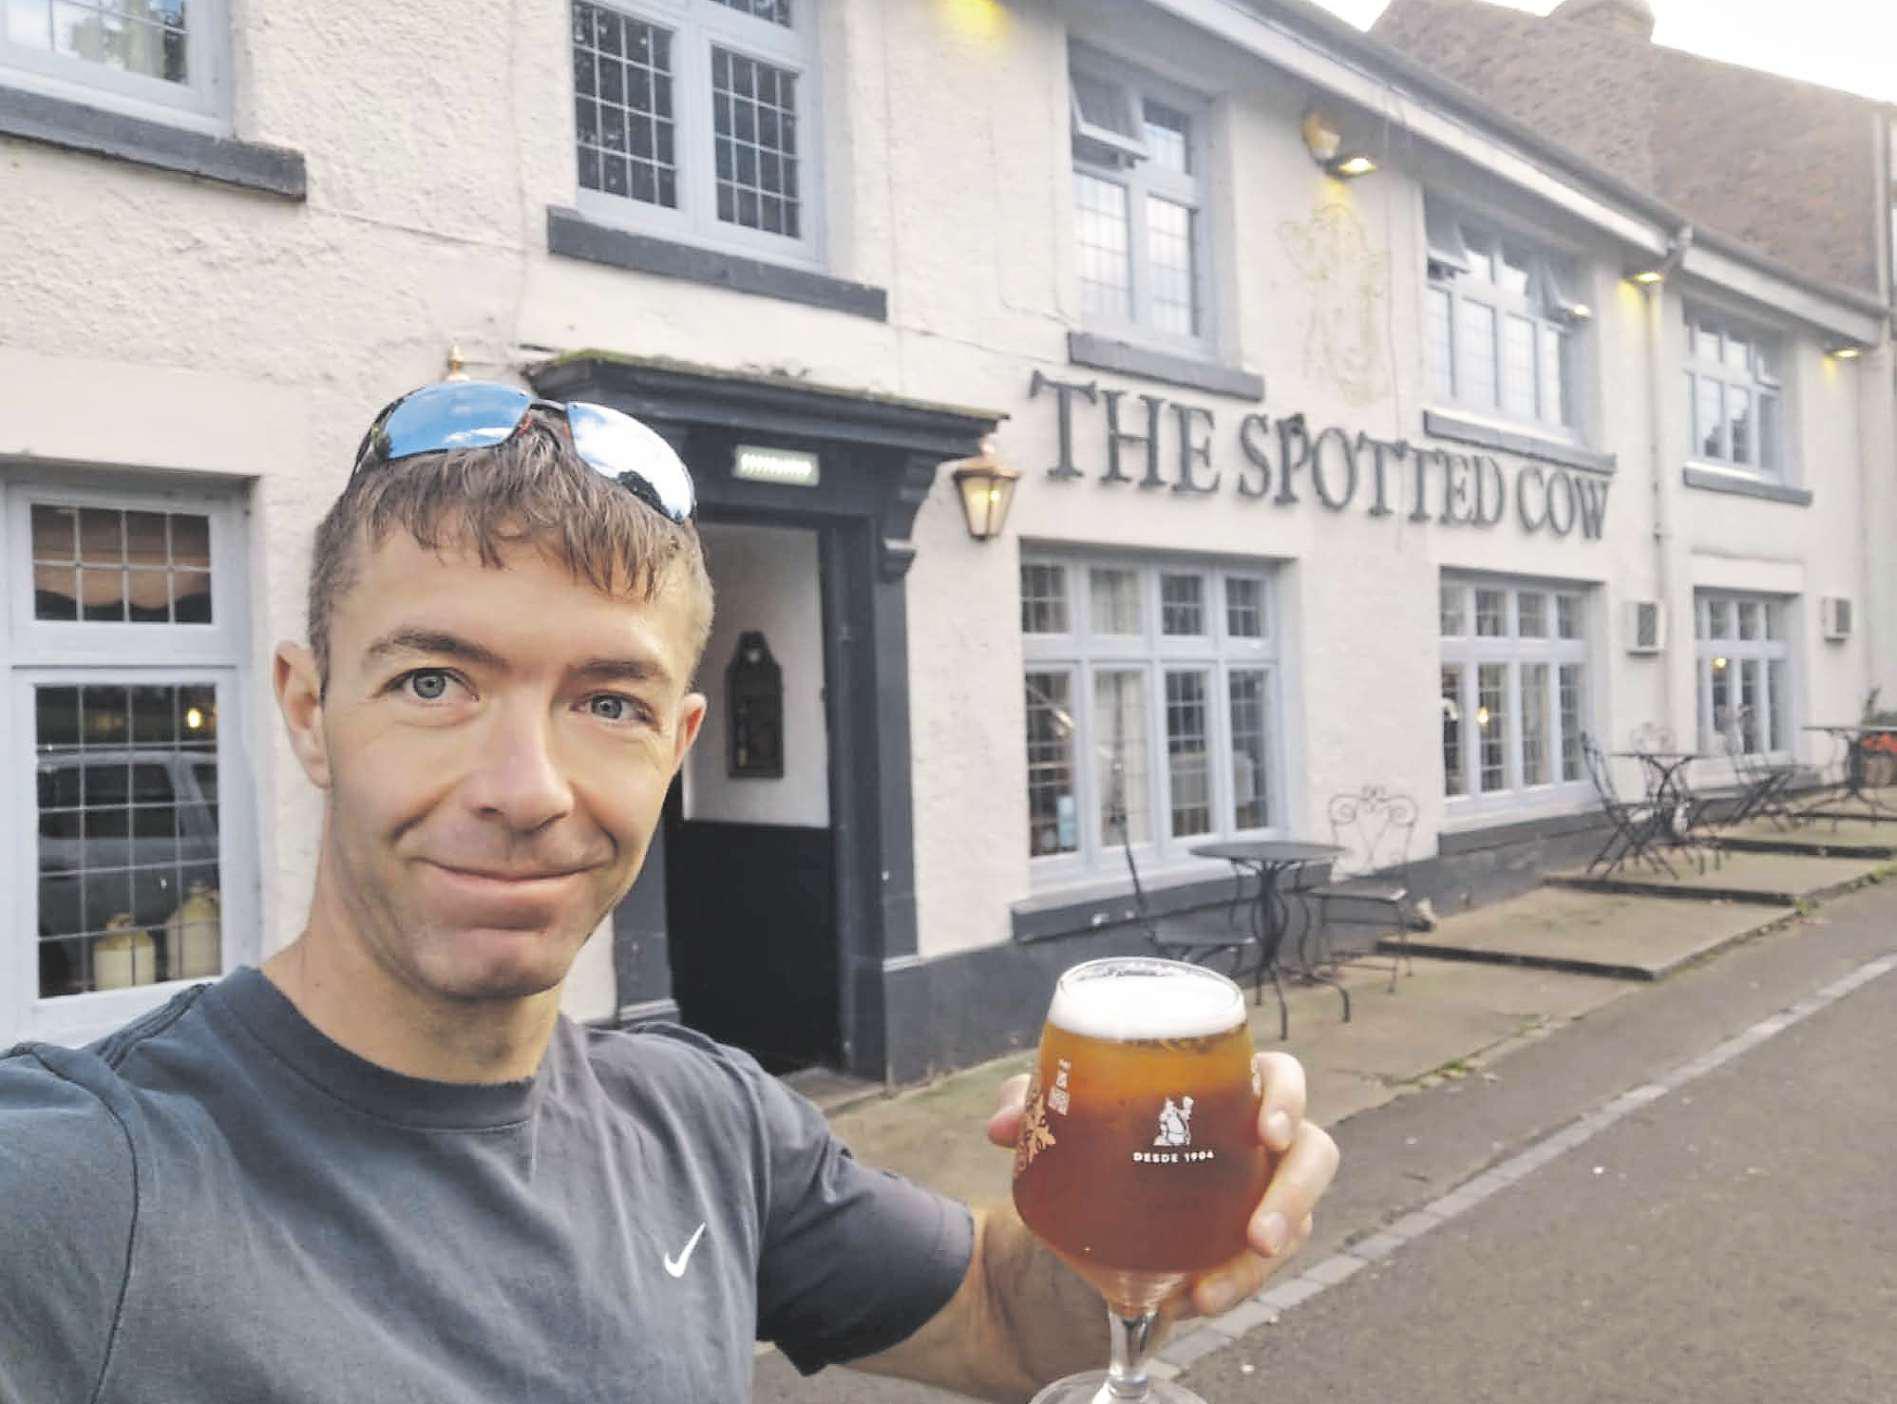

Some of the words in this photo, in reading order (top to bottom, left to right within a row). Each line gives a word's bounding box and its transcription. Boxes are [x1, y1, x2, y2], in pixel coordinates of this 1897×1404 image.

[1029, 370, 1221, 496] THE
[1238, 412, 1504, 527] SPOTTED
[1516, 465, 1613, 541] COW
[1133, 1152, 1178, 1163] DESDE
[1184, 1150, 1214, 1162] 1904
